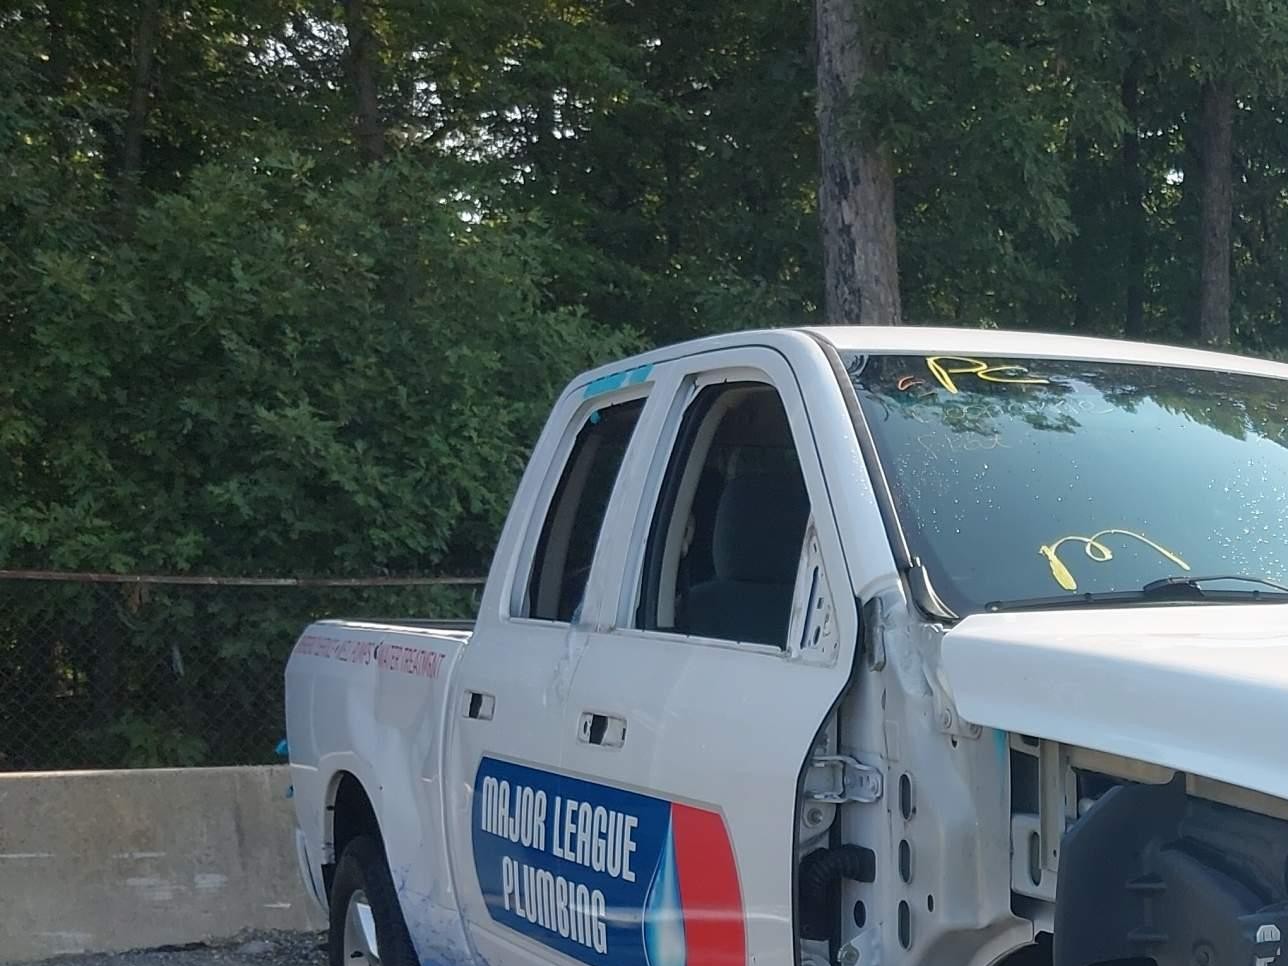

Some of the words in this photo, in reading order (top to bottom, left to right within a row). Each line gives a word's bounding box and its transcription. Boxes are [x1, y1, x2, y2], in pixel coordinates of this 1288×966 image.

[481, 775, 547, 851] MAJOR
[552, 796, 639, 883] LEAGUE
[502, 856, 608, 955] PLUMBING
